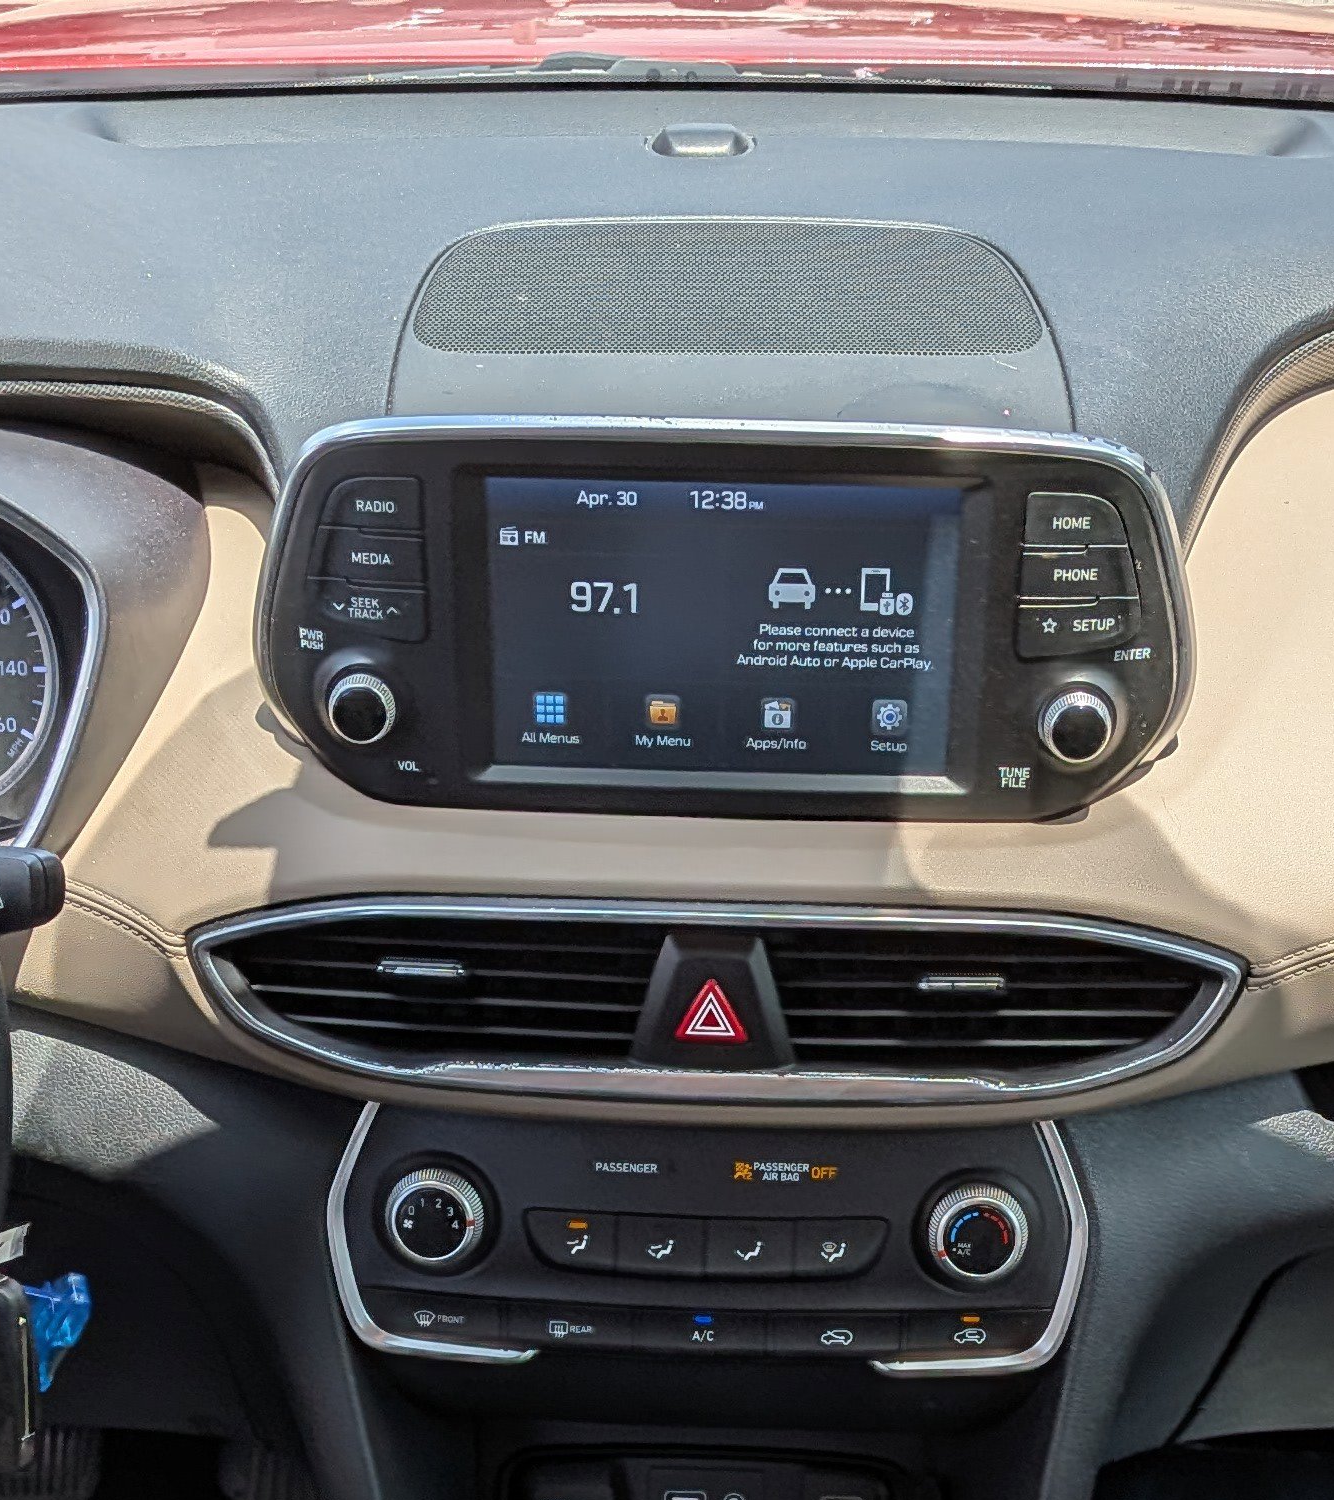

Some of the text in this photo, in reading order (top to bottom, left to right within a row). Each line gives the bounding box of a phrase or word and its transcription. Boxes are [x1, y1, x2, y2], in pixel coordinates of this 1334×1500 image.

[576, 491, 638, 509] Apr. 30
[355, 500, 395, 514] RADIO
[1052, 517, 1091, 530] HOME
[524, 531, 547, 545] FM
[351, 552, 391, 566] MEDIA
[1053, 568, 1098, 582] PHONE
[350, 597, 380, 609] SEEK
[569, 581, 640, 615] 97.1
[348, 608, 384, 620] TRACK
[759, 624, 915, 639] Please connect a device
[1072, 618, 1116, 632] SETUP
[299, 627, 325, 642] PWR
[300, 638, 325, 651] PUSH
[753, 640, 920, 655] for more features such as
[1113, 648, 1151, 661] ENTER
[737, 654, 935, 672] Android Auto or Apple CarPlay.
[521, 731, 581, 746] All Menus
[635, 734, 692, 750] My Menu
[746, 738, 807, 753] Apps/Info
[870, 740, 908, 754] Setup
[397, 760, 420, 772] VOL
[998, 767, 1031, 779] TUNE
[1000, 777, 1026, 789] FILE
[595, 1161, 658, 1174] PASSENGER
[753, 1162, 810, 1173] PASSENGER
[811, 1167, 838, 1179] OFF
[762, 1172, 800, 1182] AIR BAG
[420, 1198, 425, 1208] 1
[435, 1199, 443, 1209] 2
[408, 1206, 415, 1216] 0
[446, 1206, 454, 1217] 3
[451, 1220, 459, 1230] 4
[437, 1314, 465, 1325] FRONT
[569, 1325, 593, 1335] REAR
[692, 1330, 715, 1342] A/C
